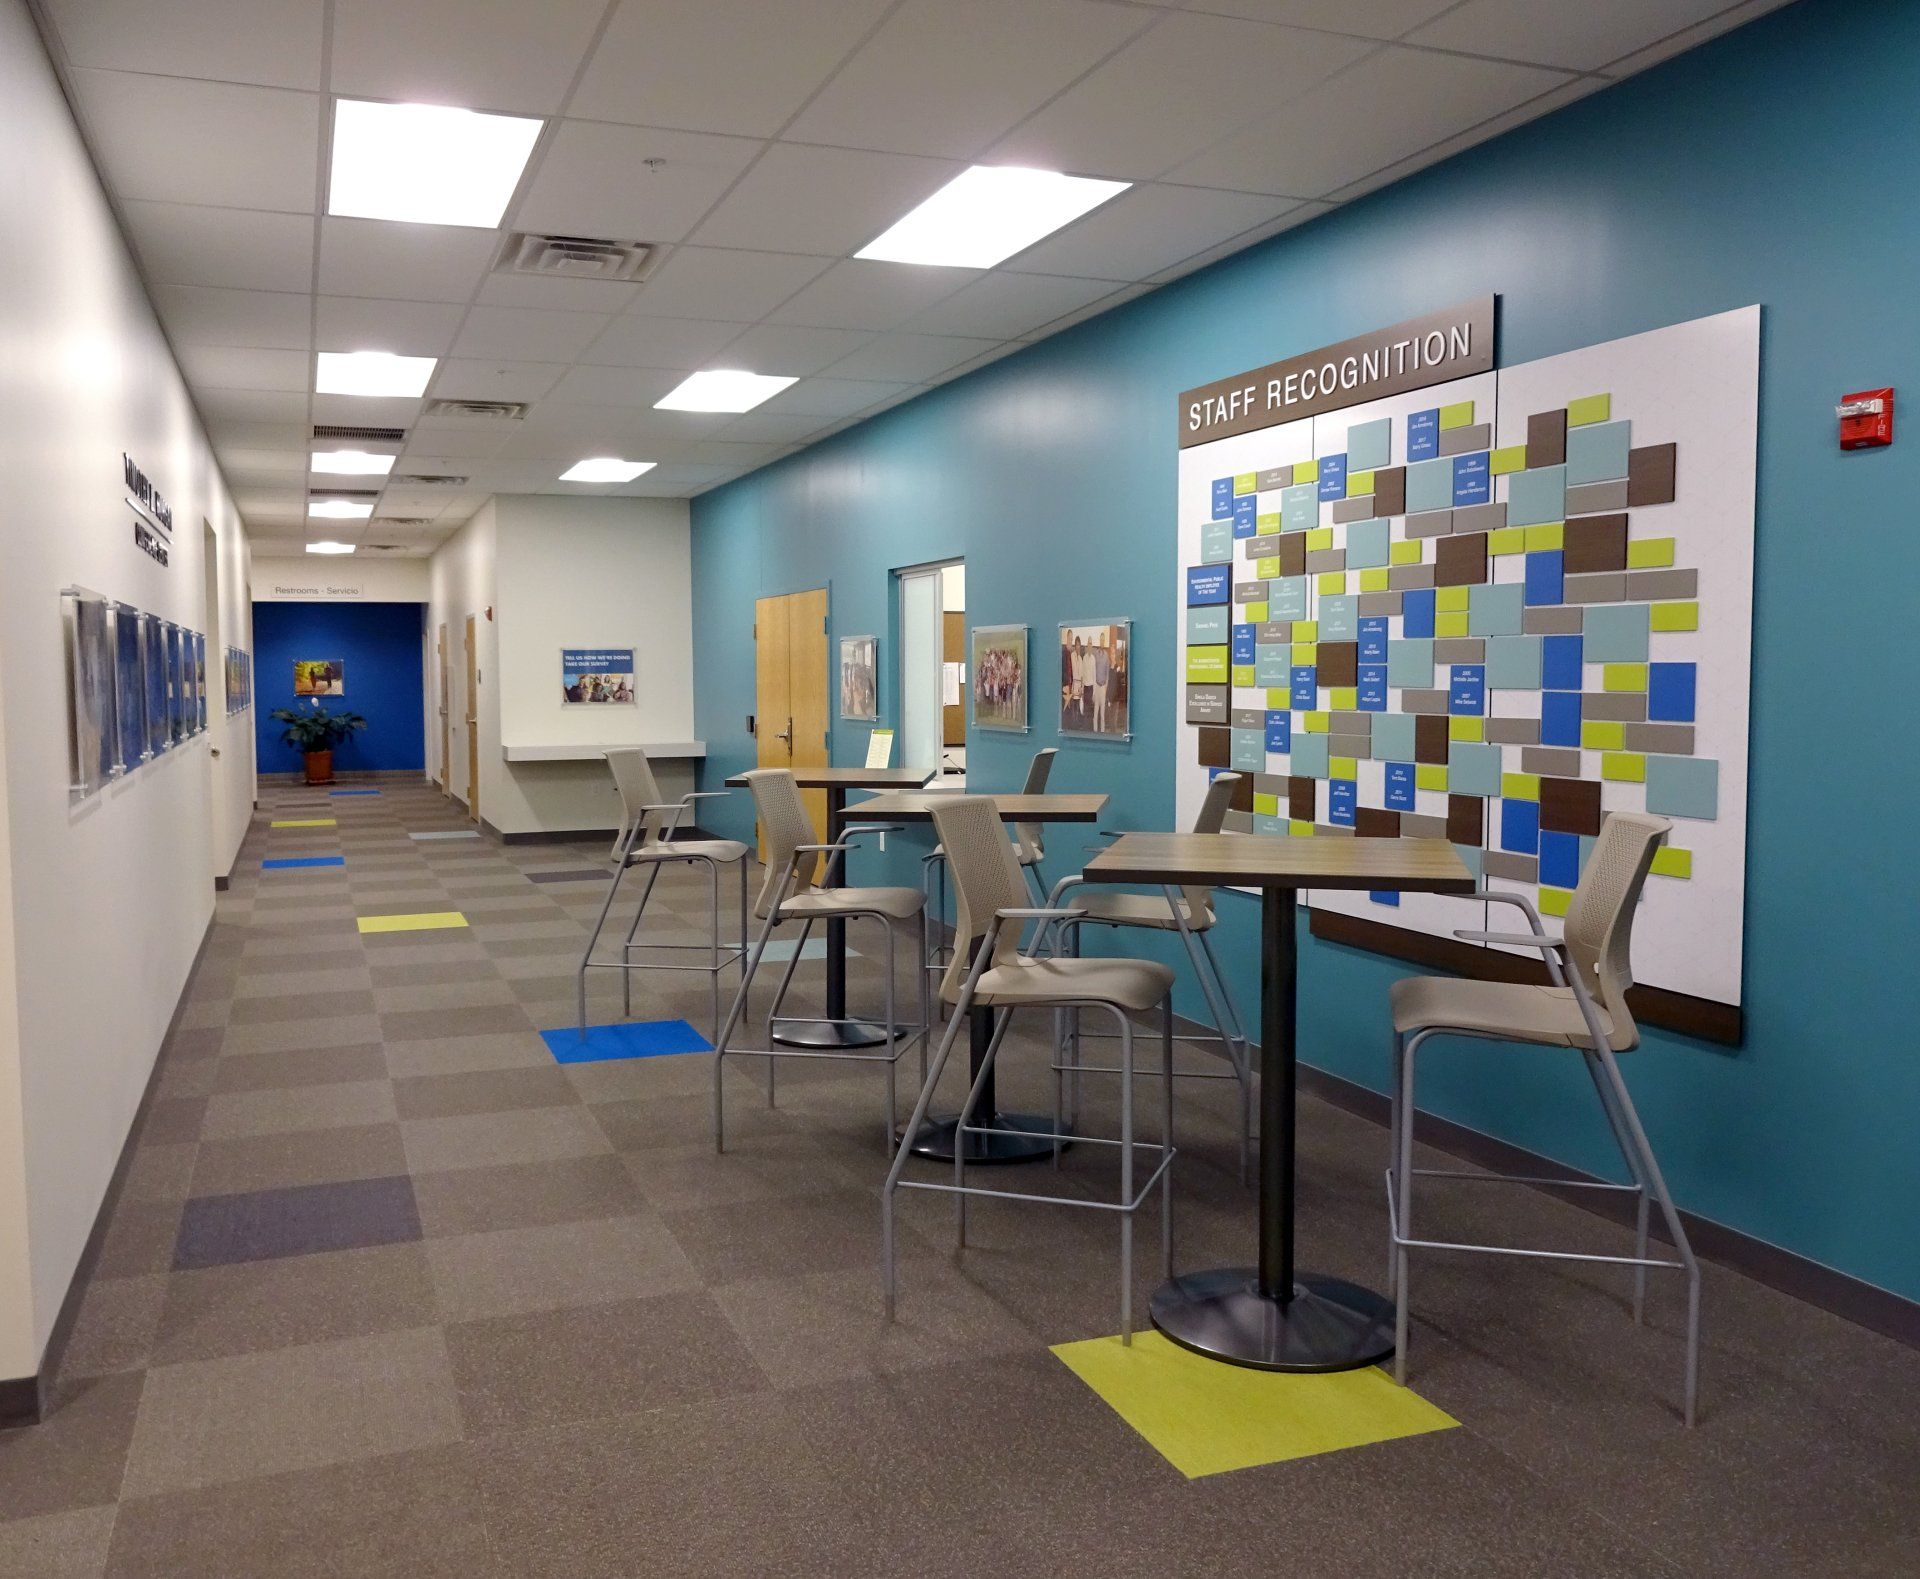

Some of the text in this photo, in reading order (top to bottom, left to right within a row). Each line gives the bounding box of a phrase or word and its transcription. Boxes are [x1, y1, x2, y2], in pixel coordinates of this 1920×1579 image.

[1188, 322, 1472, 431] STAFF RECOGNITION
[275, 586, 319, 595] Restrooms
[326, 587, 359, 595] Servicio
